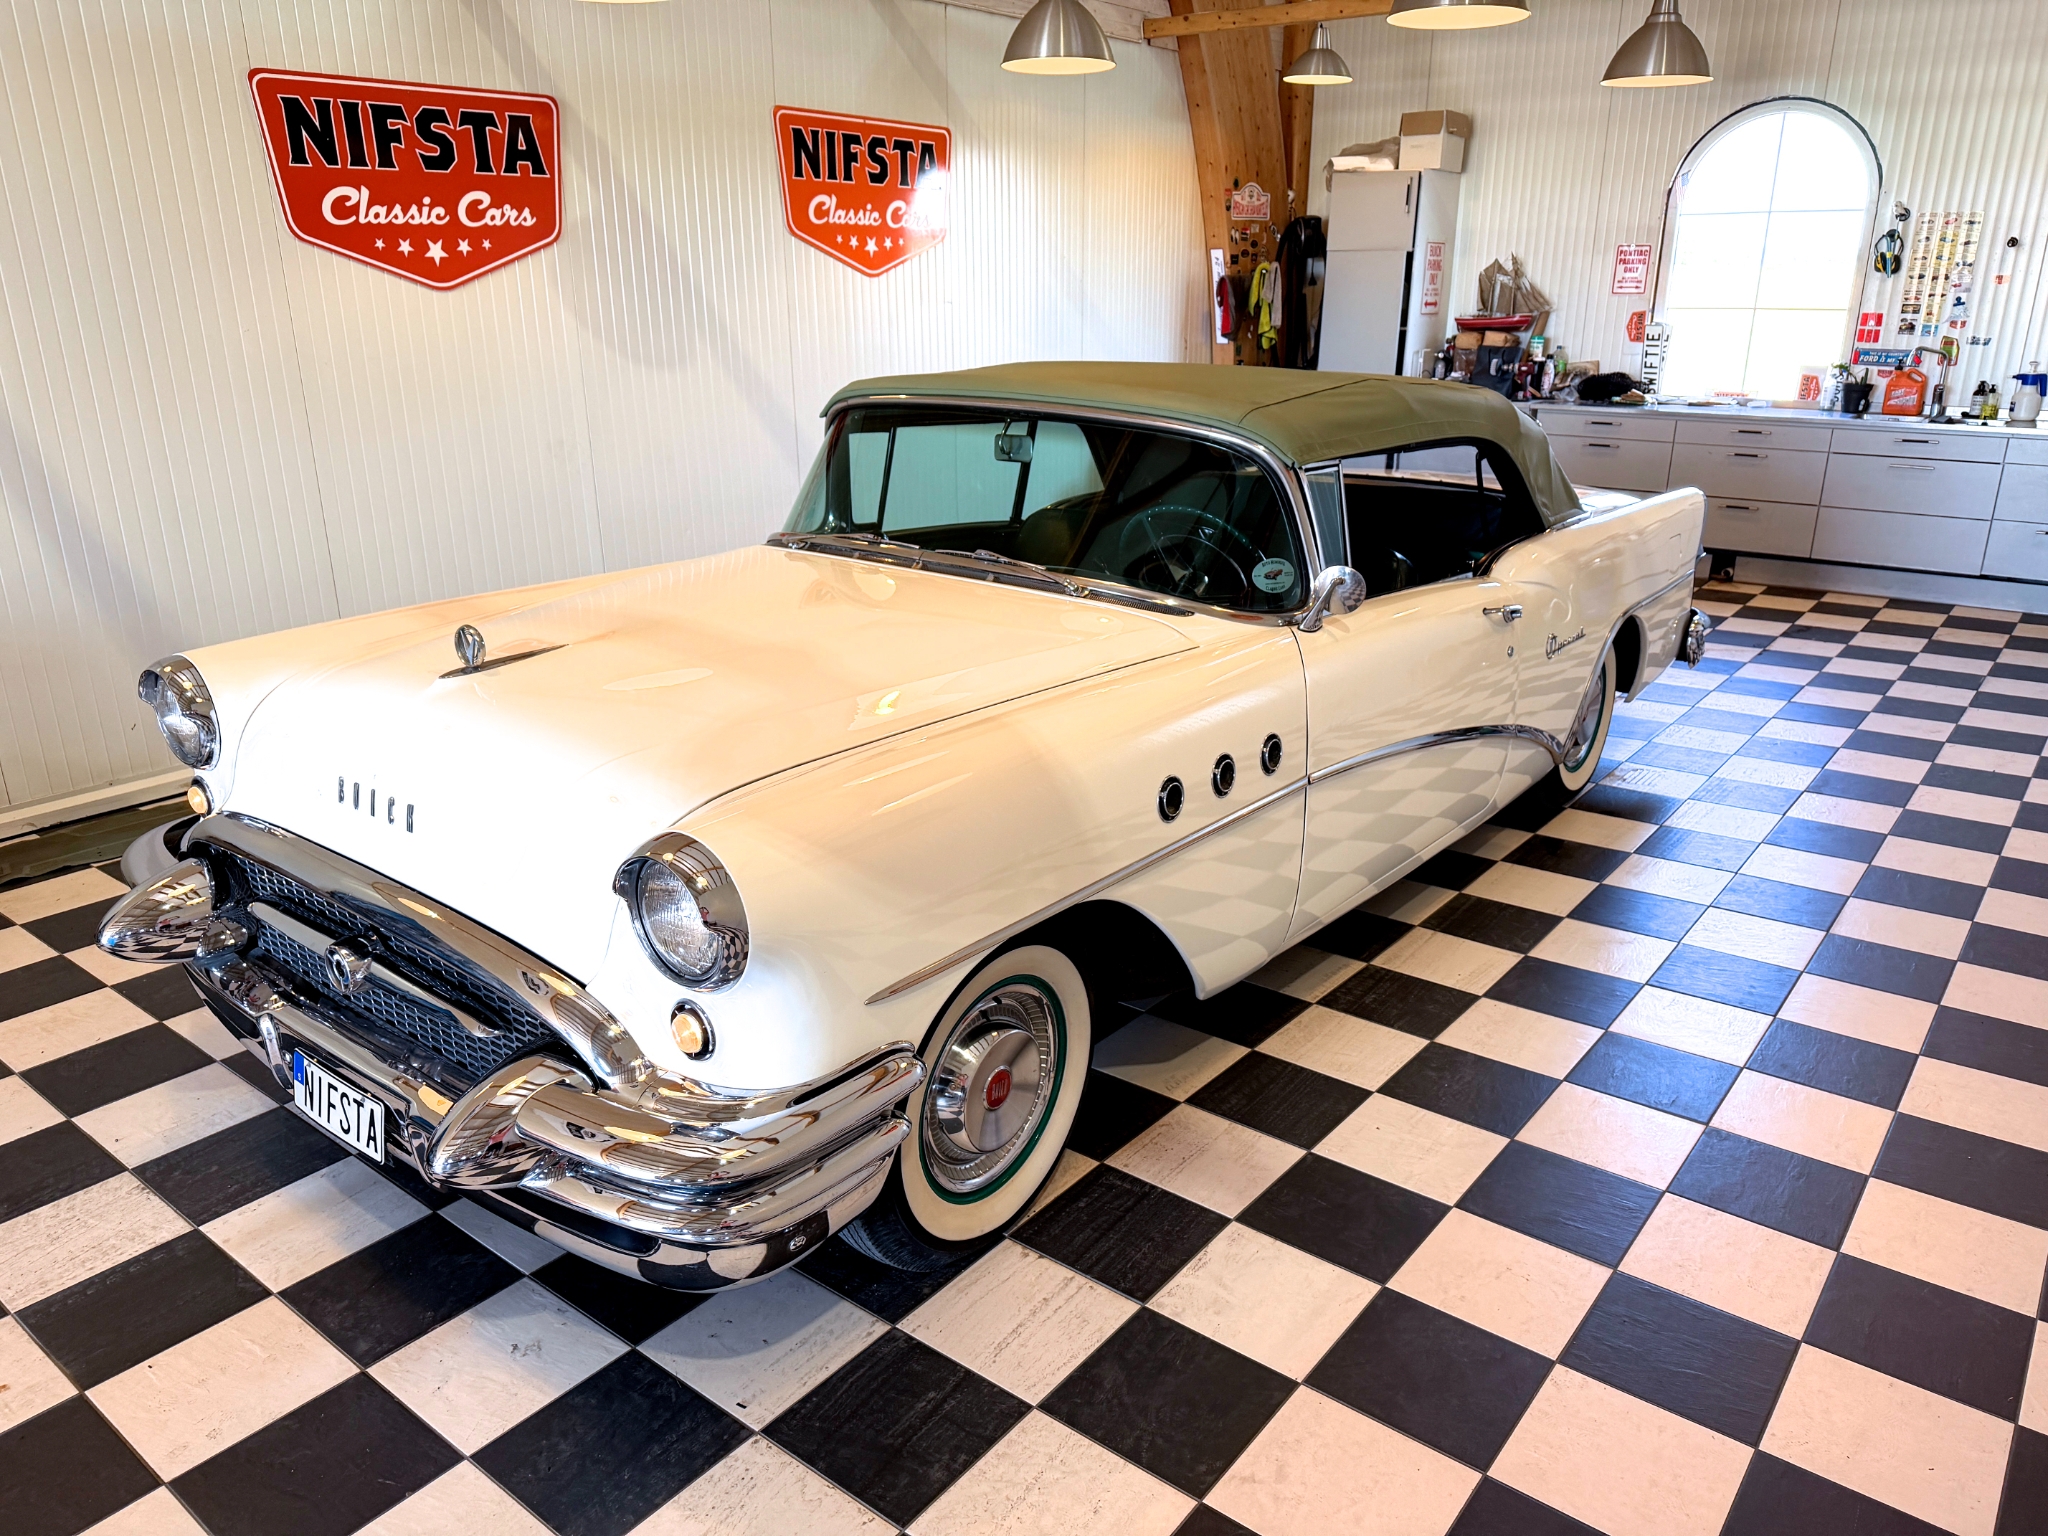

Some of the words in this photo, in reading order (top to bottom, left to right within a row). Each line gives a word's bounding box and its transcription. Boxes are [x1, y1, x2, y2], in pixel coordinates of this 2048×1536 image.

[277, 94, 550, 178] NIFSTA
[789, 125, 942, 190] NIFSTA
[321, 185, 450, 226] Classic
[457, 190, 537, 228] Cars
[808, 194, 882, 226] Classic
[1618, 257, 1647, 265] PARKING
[1619, 249, 1648, 257] PONTIAC
[1623, 266, 1640, 274] ONLY
[1642, 332, 1661, 394] SWIFTIE
[338, 776, 414, 833] BUICK
[304, 1065, 378, 1154] NIFSTA
